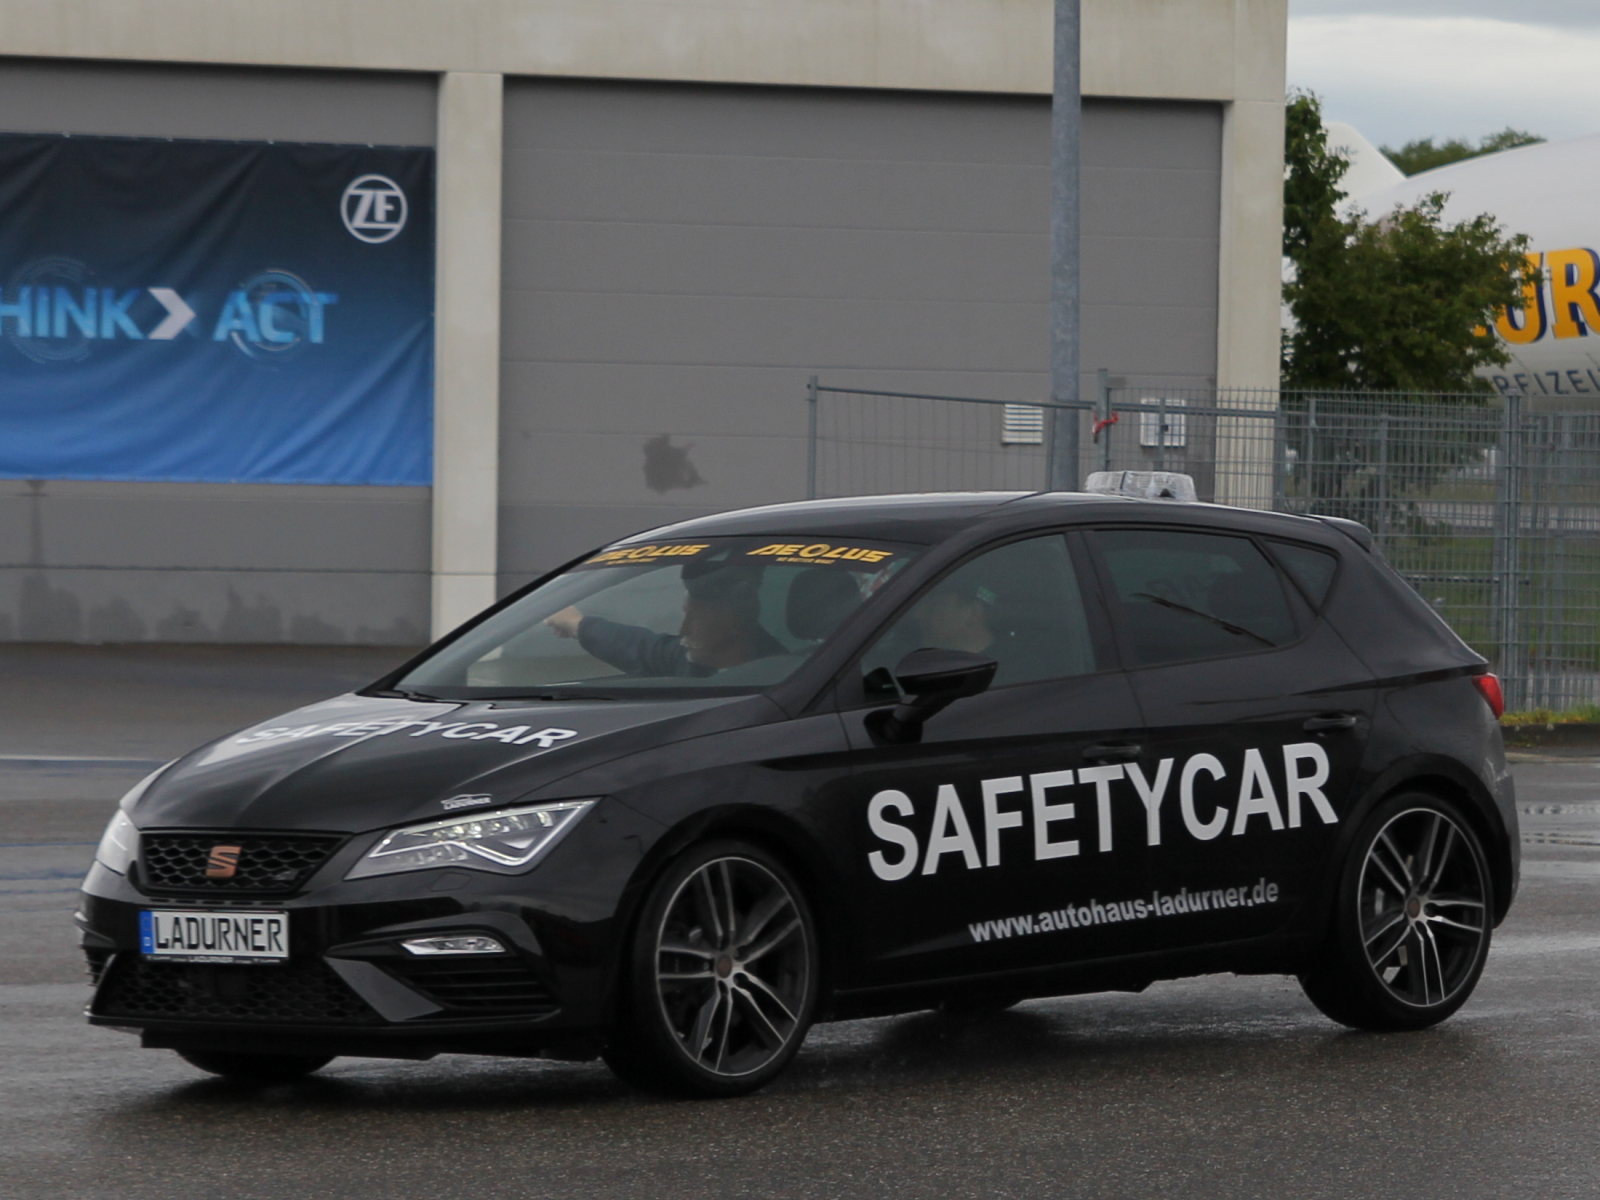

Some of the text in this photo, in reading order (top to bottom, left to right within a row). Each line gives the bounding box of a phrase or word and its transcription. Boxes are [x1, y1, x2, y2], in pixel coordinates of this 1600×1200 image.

[346, 188, 401, 230] ZF
[213, 290, 339, 344] ACT
[1473, 248, 1600, 345] UR
[746, 543, 894, 563] AEOLUS
[235, 720, 578, 748] SAFETYCAR
[867, 742, 1339, 882] SAFETYCAR
[154, 916, 284, 952] LADURNER
[968, 877, 1279, 943] www.autohaus-ladurner.de
